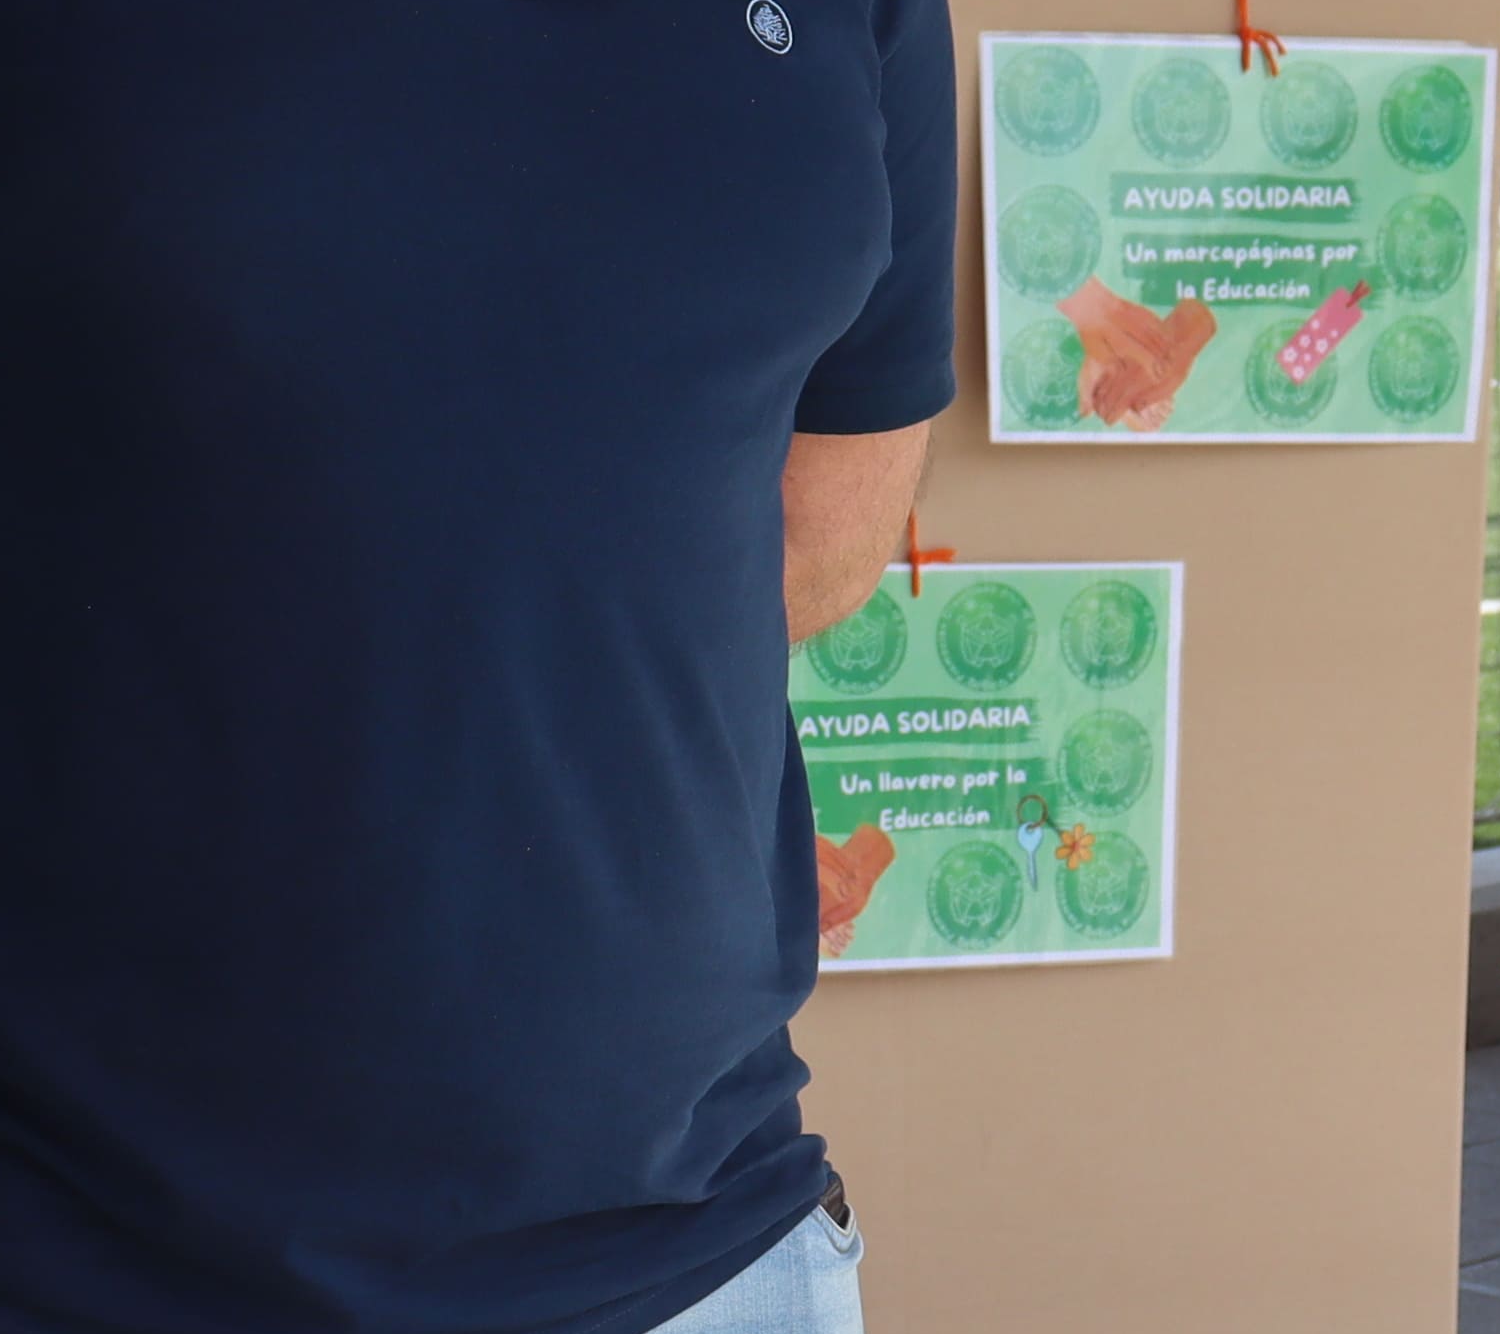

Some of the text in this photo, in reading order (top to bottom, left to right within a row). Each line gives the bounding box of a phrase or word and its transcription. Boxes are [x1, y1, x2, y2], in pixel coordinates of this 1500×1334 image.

[1123, 185, 1351, 211] AYUDA SOLIDARIA
[1125, 238, 1359, 269] Un marcapáginas por
[1177, 278, 1311, 301] la Educación
[799, 705, 1031, 738] AYUDA SOLIDARIA
[840, 765, 1027, 795] Un llavero por la
[878, 807, 991, 833] Educación
